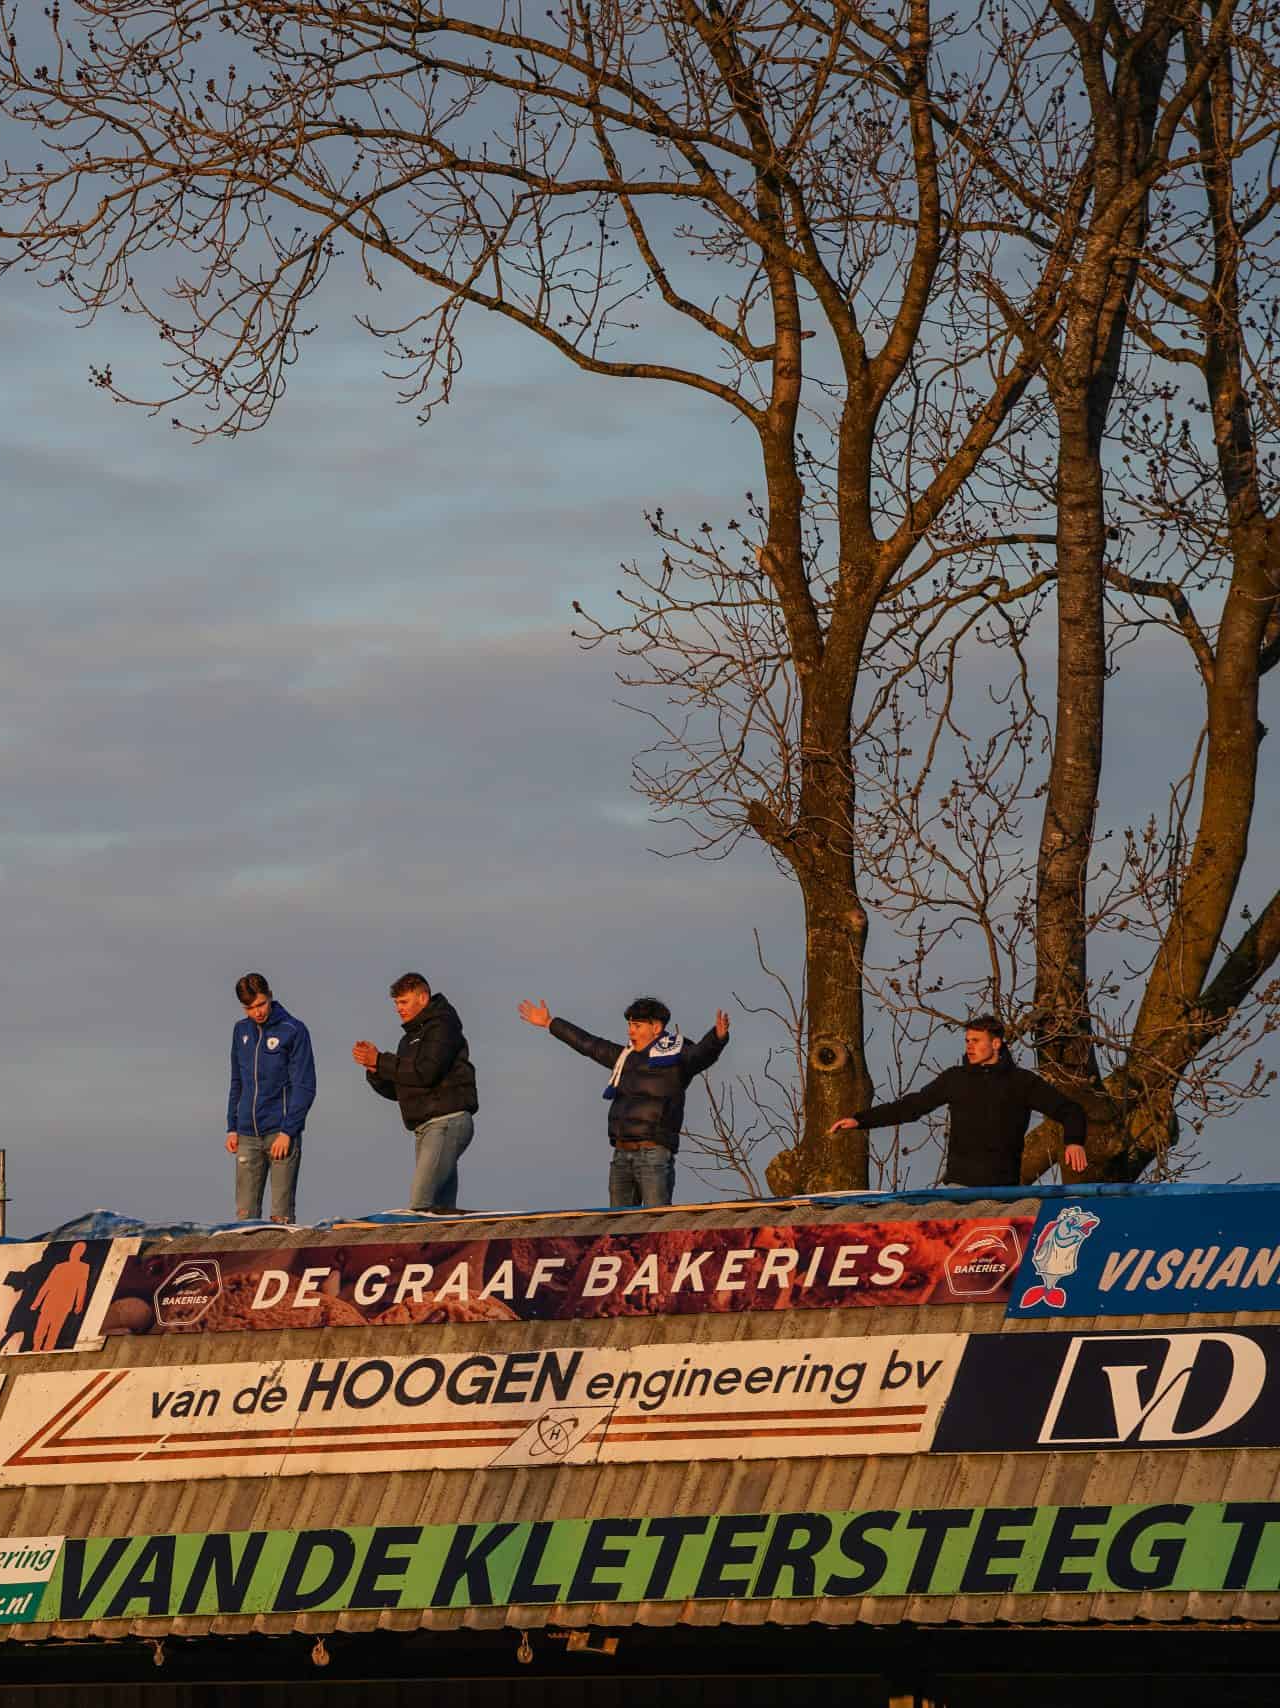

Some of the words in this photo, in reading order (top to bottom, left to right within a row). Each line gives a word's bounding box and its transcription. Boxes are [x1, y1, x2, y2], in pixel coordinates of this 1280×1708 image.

[250, 1266, 329, 1310] DE
[353, 1257, 566, 1307] GRAAF
[583, 1243, 910, 1298] BAKERIES
[953, 1264, 1007, 1274] BAKERIES
[1097, 1245, 1280, 1292] VISHAN
[161, 1295, 209, 1306] BAKERIES
[150, 1386, 221, 1419] van
[232, 1375, 288, 1414] de
[298, 1351, 584, 1414] HOOGEN
[585, 1353, 867, 1411] engineering
[880, 1349, 943, 1392] bv
[549, 1428, 561, 1441] H
[58, 1530, 268, 1620] VAN
[271, 1526, 424, 1612] DE
[430, 1503, 1195, 1607] KLETERSTEEG
[1222, 1503, 1280, 1589] T
